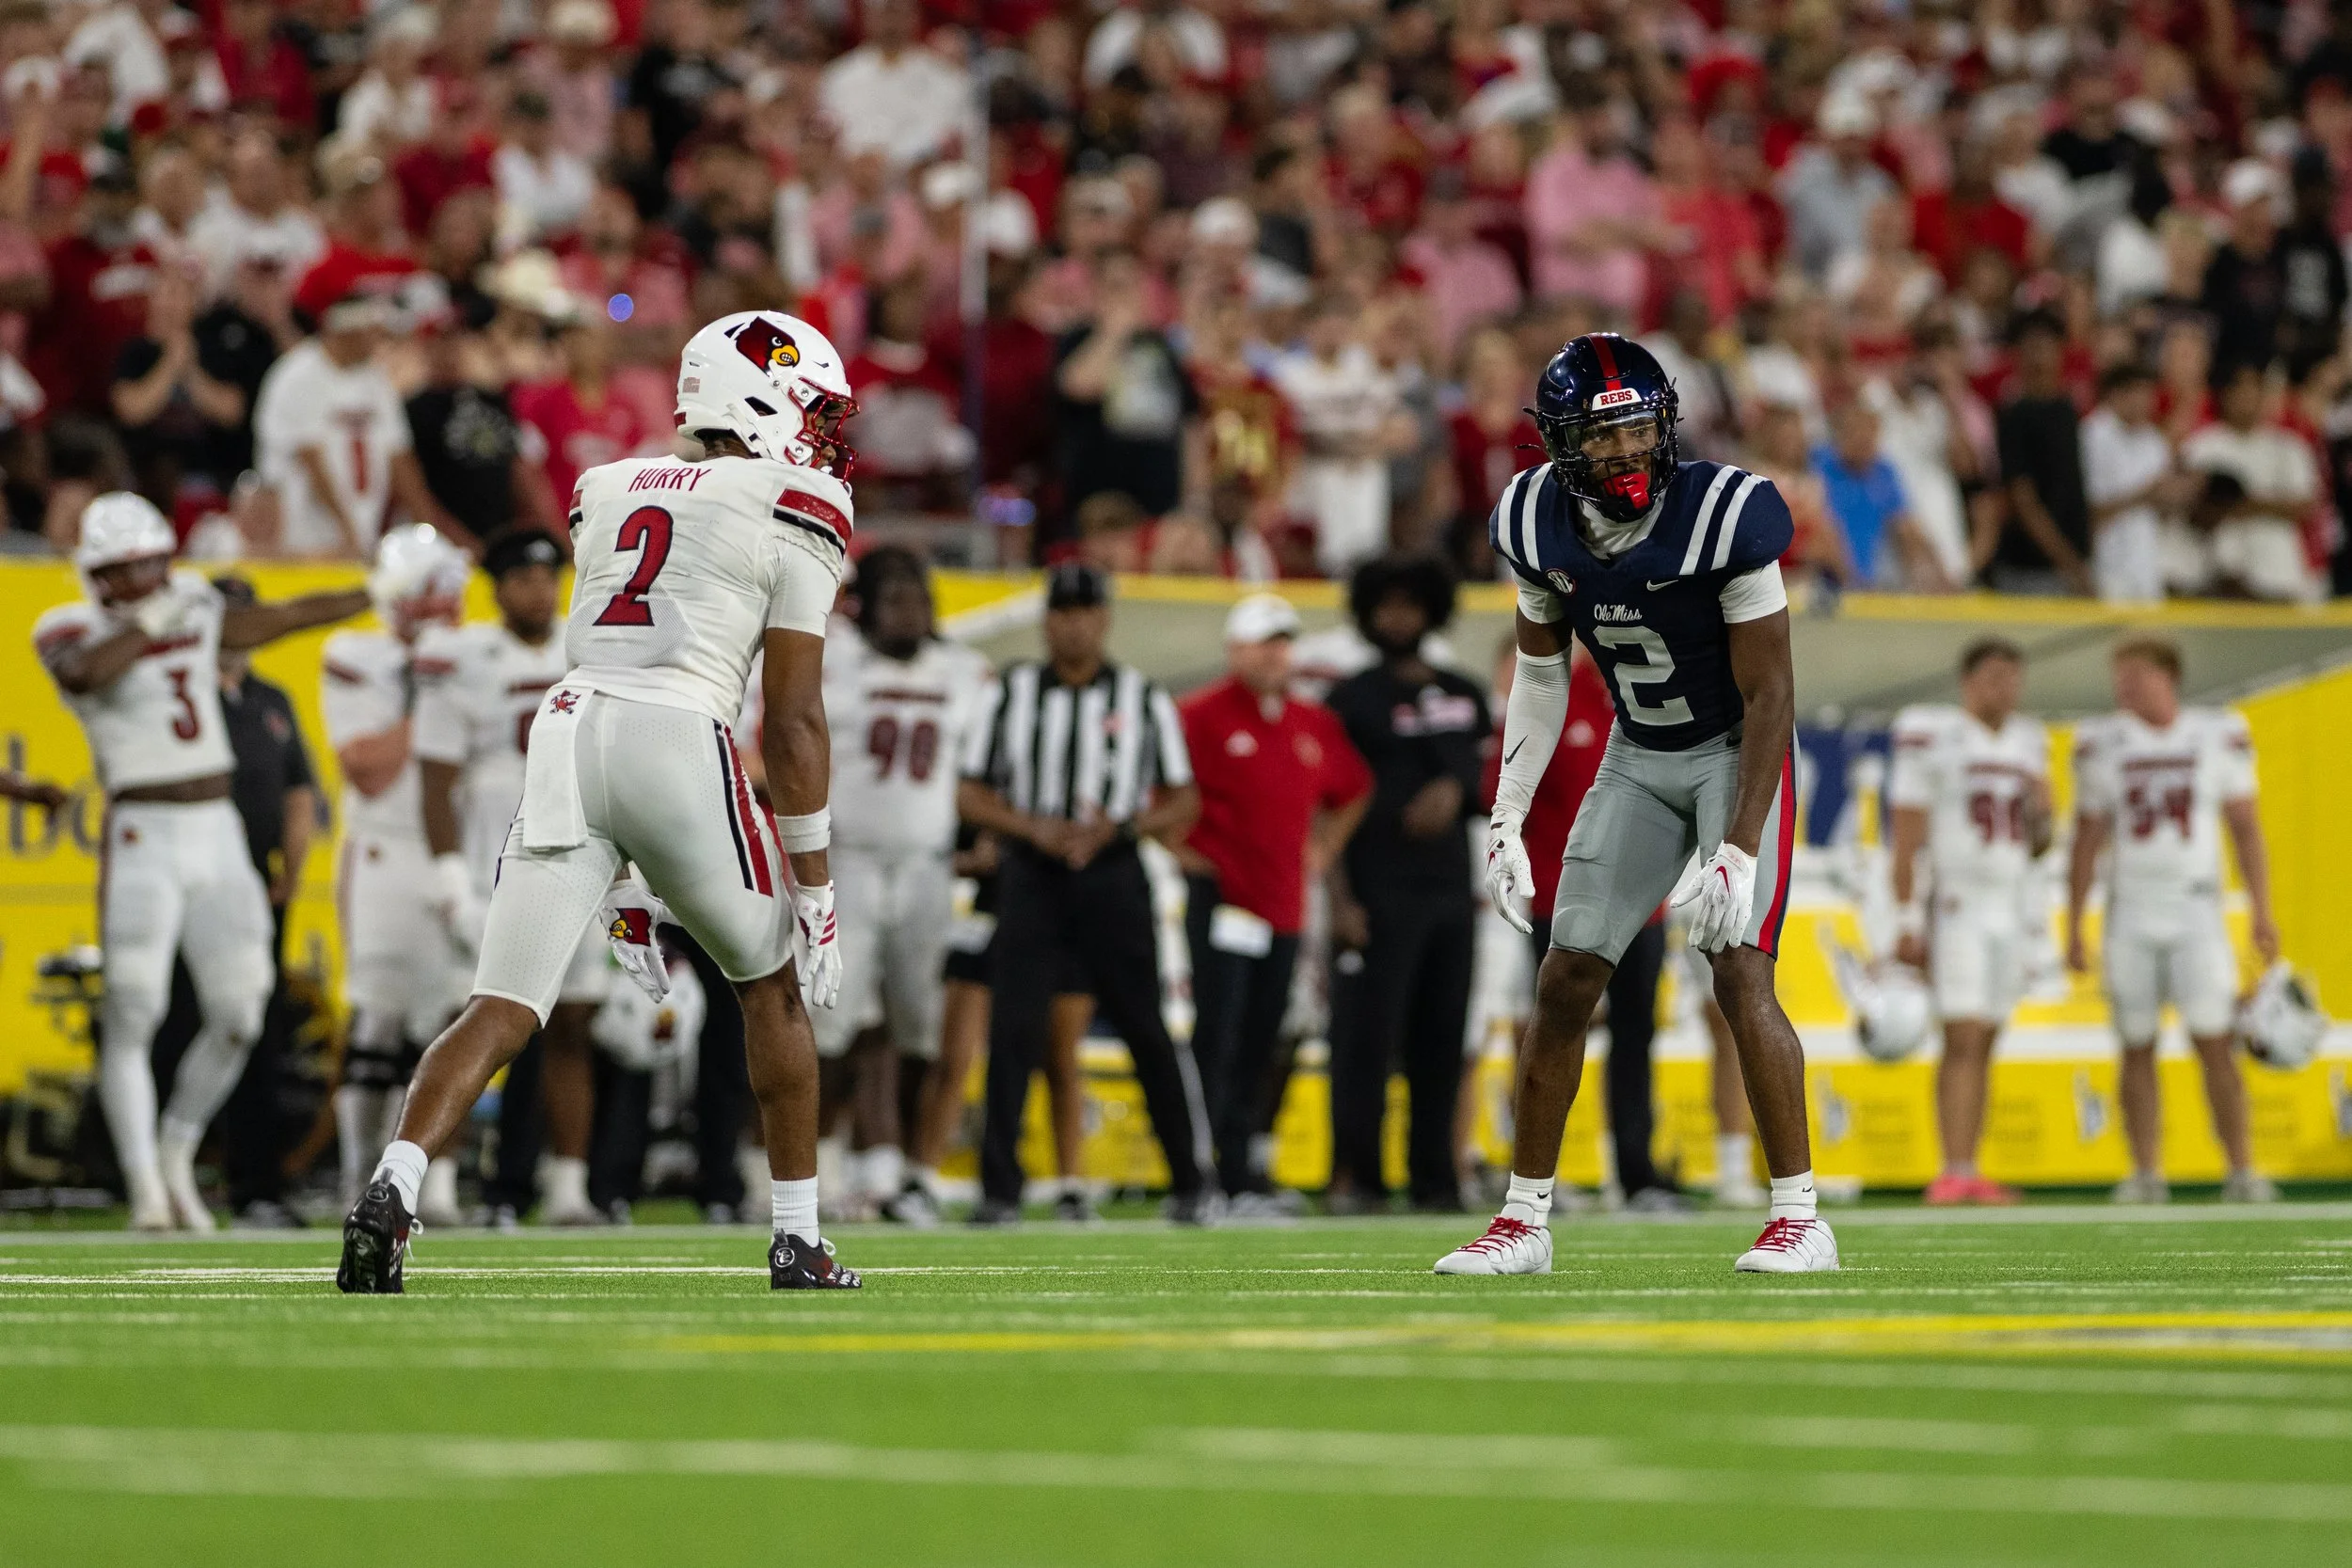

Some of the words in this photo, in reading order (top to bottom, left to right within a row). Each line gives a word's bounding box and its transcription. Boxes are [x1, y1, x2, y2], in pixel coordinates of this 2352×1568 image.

[1600, 390, 1633, 405] REBS
[628, 467, 712, 493] HURRY
[592, 504, 674, 626] 2
[1594, 603, 1612, 622] Ole
[1610, 604, 1643, 622] Miss
[168, 667, 199, 740] 3
[1593, 625, 1694, 726] 2
[867, 715, 940, 783] 90
